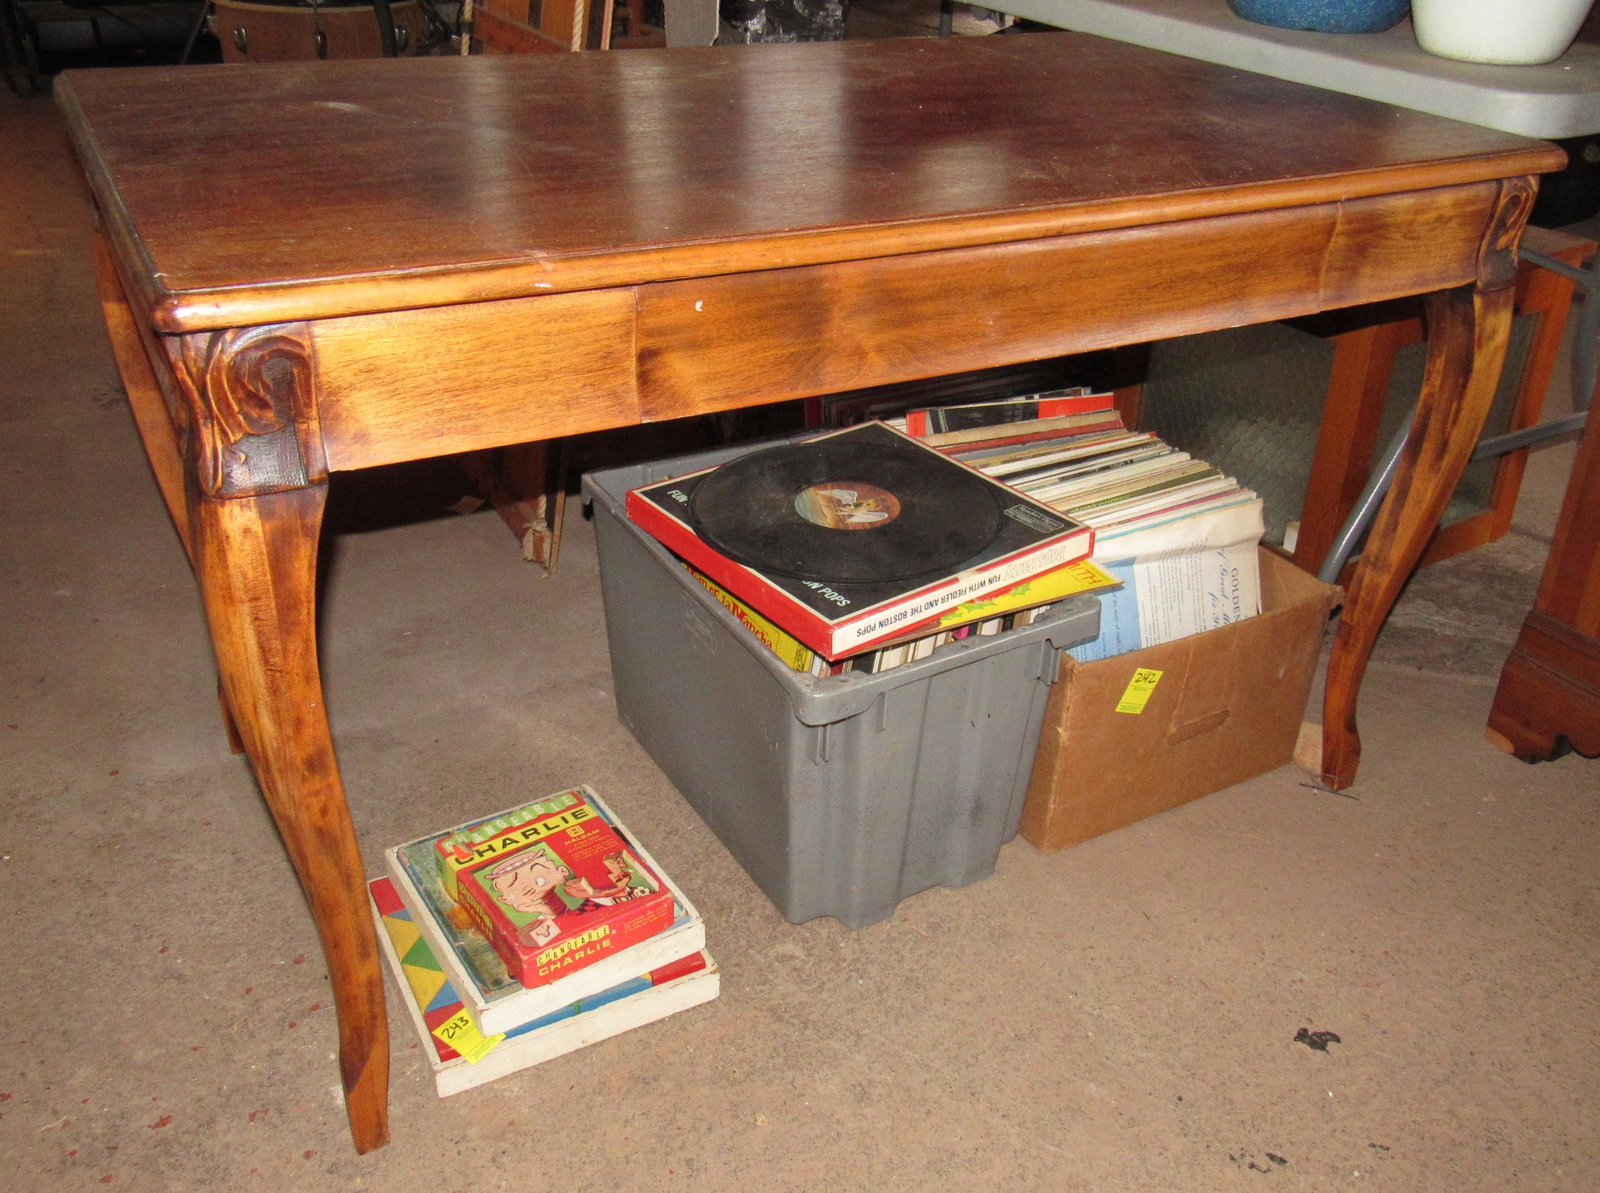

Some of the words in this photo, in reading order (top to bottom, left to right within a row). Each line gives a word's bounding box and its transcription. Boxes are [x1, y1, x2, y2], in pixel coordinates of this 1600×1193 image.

[667, 489, 689, 503] FUN
[988, 573, 1001, 586] FUN
[1067, 563, 1104, 585] ITH
[940, 586, 967, 605] FIEDLER
[968, 578, 987, 594] WITH
[817, 587, 851, 607] POPS
[924, 598, 944, 611] AND
[878, 609, 908, 628] BOSTON
[910, 605, 923, 618] THE
[856, 624, 877, 638] POPS
[1134, 672, 1156, 684] 242
[442, 795, 576, 853] CHANGEABLE
[538, 926, 609, 966] CHANGEABLE
[538, 938, 612, 977] CHARLIE
[440, 1016, 469, 1040] 243
